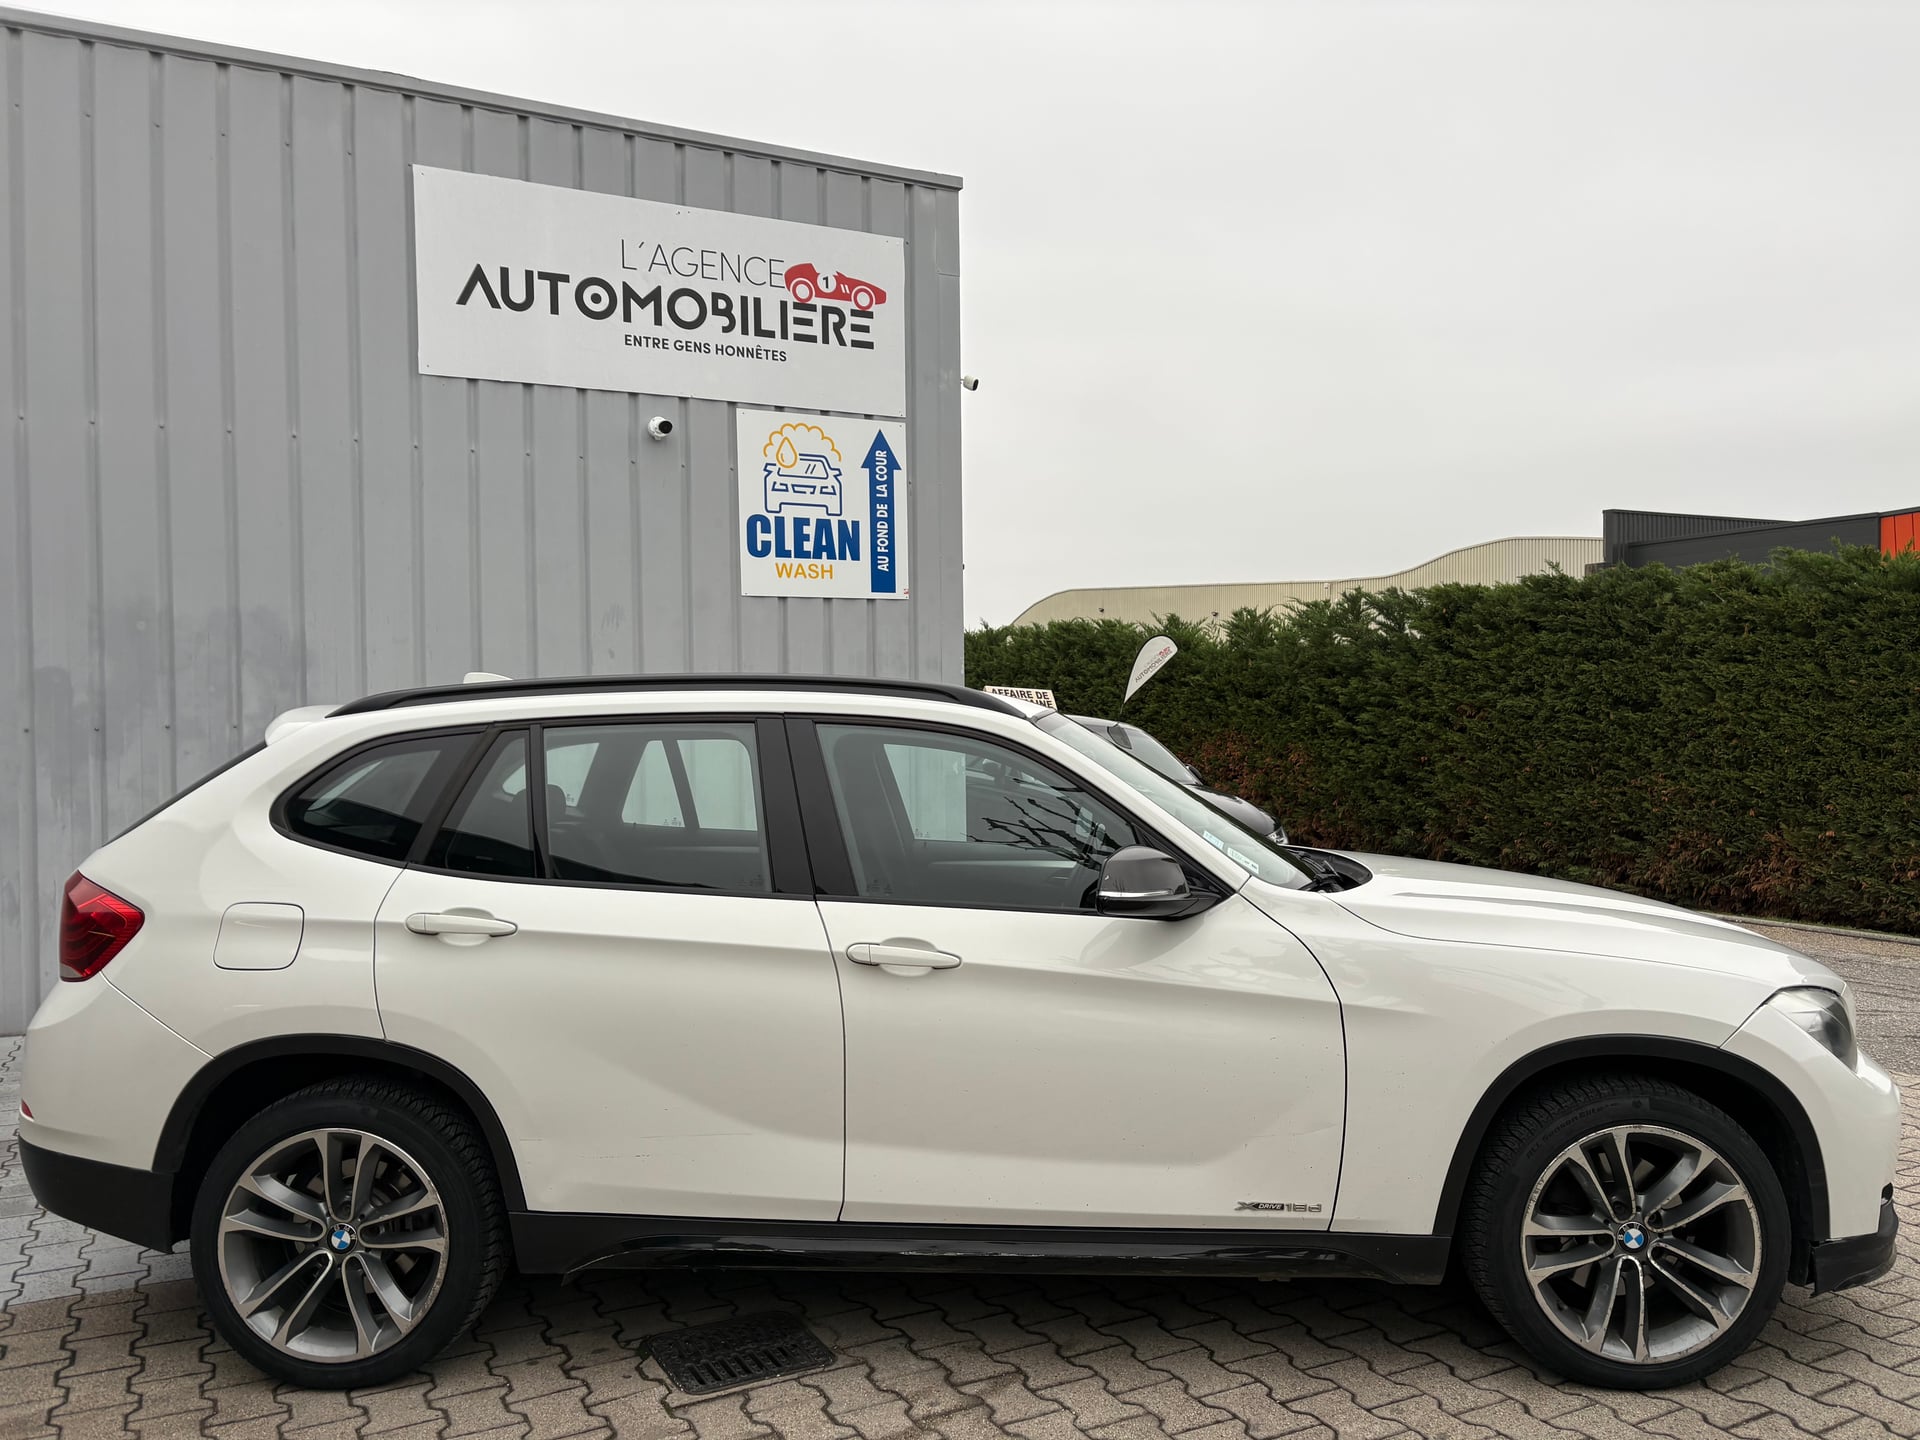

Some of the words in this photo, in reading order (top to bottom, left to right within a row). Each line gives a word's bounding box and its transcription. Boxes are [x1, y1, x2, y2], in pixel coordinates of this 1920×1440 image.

[822, 275, 830, 289] 1
[455, 263, 875, 350] AUTOMOBILIERE
[624, 334, 670, 350] ENTRE
[673, 339, 711, 354] GENS
[715, 344, 787, 362] HONNÊTES
[875, 450, 888, 482] COUR
[875, 483, 888, 498] LA
[875, 503, 889, 519] DE
[746, 514, 860, 561] CLEAN
[876, 520, 889, 556] FOND
[775, 562, 834, 579] WASH
[876, 557, 889, 572] AU
[991, 687, 1034, 699] AFFAIRE
[1035, 690, 1050, 700] DE
